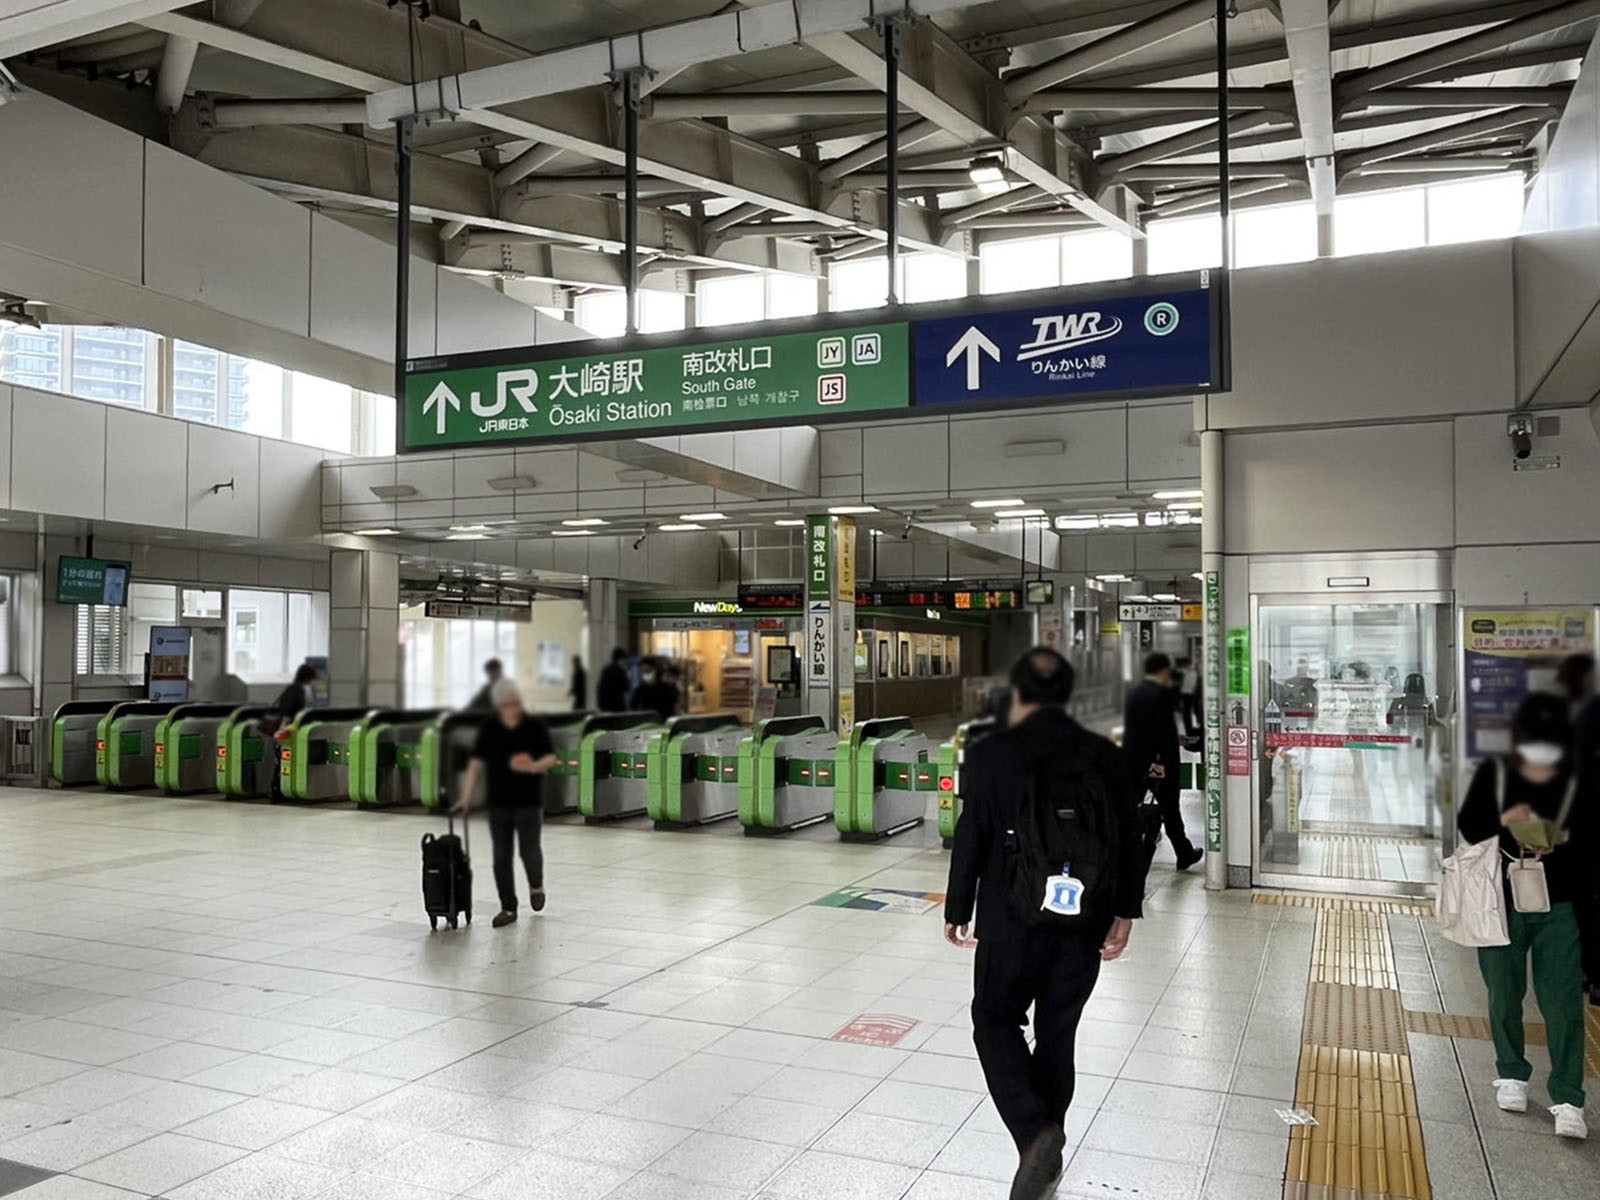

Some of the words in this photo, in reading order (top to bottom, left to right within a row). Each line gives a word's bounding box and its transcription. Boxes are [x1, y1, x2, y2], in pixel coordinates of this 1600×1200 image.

[824, 345, 840, 359] JY
[858, 343, 875, 356] JA
[682, 346, 772, 377] 南改札口
[1031, 354, 1107, 374] りんかい線
[548, 358, 644, 400] 大崎駅
[1049, 372, 1075, 381] Rinkai
[1076, 370, 1096, 379] Line
[470, 368, 538, 417] JR
[682, 379, 720, 395] South
[723, 377, 757, 391] Gate
[825, 382, 839, 396] JS
[549, 404, 601, 426] Ōsaki
[606, 399, 673, 421] Station
[479, 417, 529, 433] JR東日本
